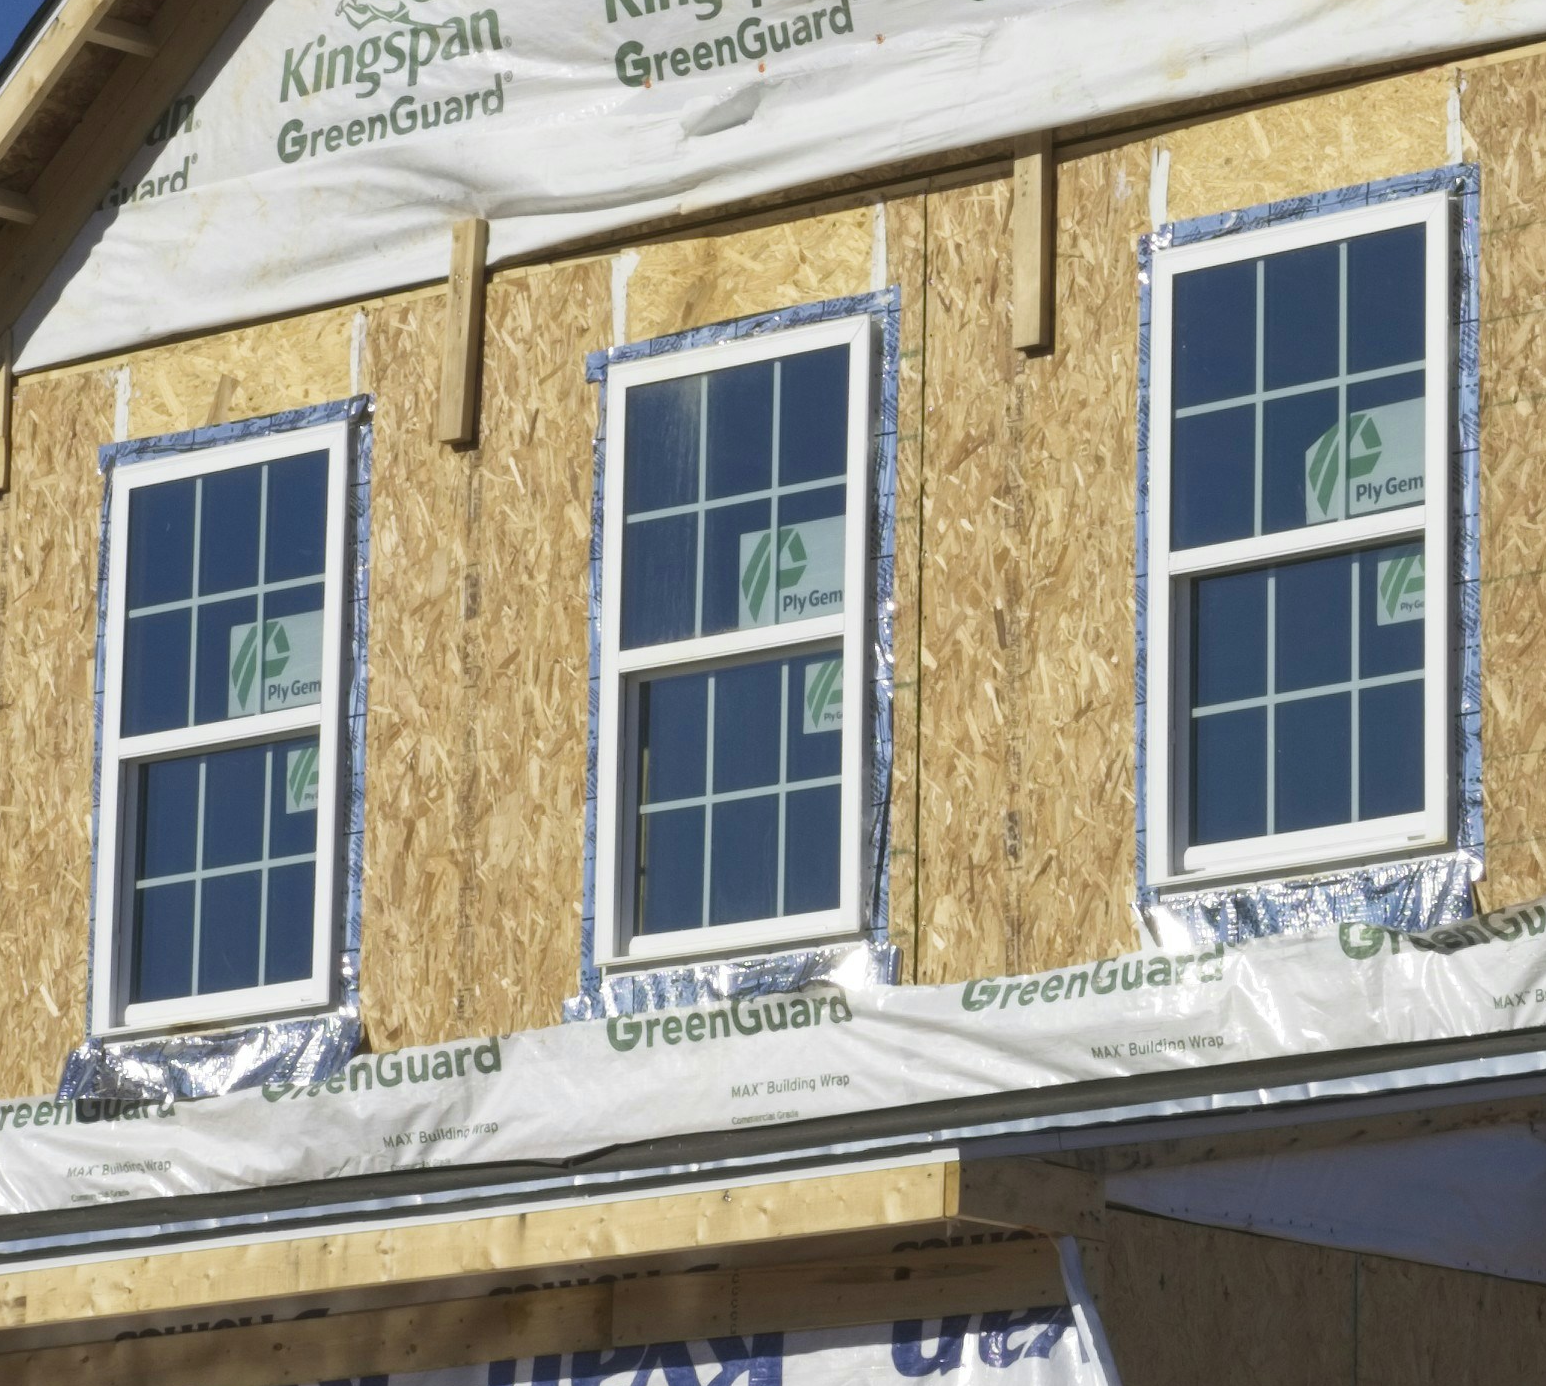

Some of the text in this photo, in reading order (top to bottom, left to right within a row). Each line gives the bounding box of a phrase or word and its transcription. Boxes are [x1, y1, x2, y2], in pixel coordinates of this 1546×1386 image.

[279, 6, 503, 102] Kingspan
[277, 76, 506, 164] GreenGuard
[1356, 475, 1423, 504] Ply Gem
[783, 589, 843, 615] Ply Gem
[268, 679, 321, 704] Ply Gem
[962, 943, 1225, 1013] GreenGuard
[1493, 991, 1527, 1011] MAX
[607, 990, 853, 1053] GreenGuard
[1092, 1033, 1225, 1061] MAX Building Wrap
[732, 1073, 851, 1099] MAX Building Wrap
[383, 1132, 412, 1149] MAX
[419, 1126, 469, 1147] Building
[67, 1159, 172, 1178] MAX Building Wrap
